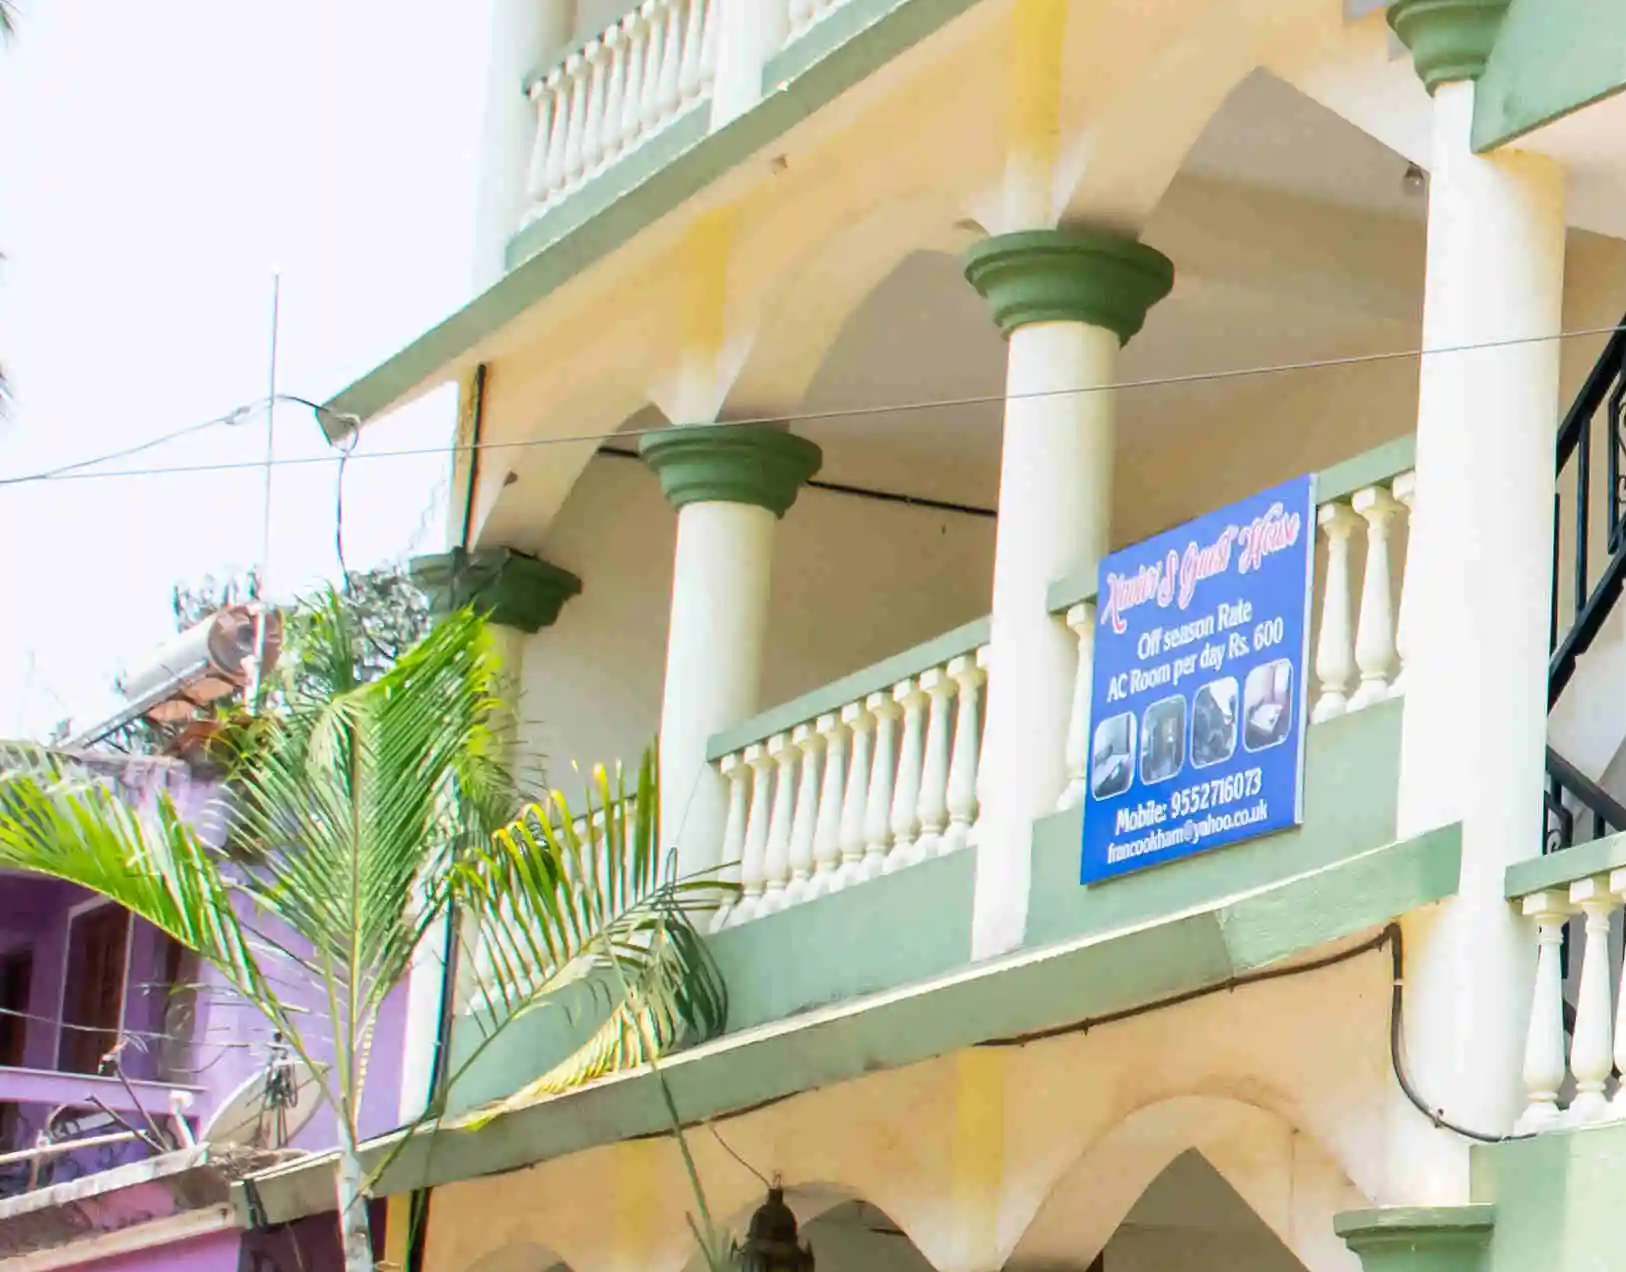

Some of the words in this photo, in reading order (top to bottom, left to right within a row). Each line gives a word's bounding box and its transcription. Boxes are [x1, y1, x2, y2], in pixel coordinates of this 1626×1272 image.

[1107, 673, 1128, 703] AC
[1130, 663, 1171, 694] Room
[1173, 653, 1198, 686] per
[1200, 642, 1226, 671] day
[1228, 632, 1250, 659] Rs.
[1253, 616, 1284, 651] 600
[1137, 628, 1162, 660] Off
[1163, 615, 1214, 651] season
[1218, 599, 1252, 631] Rate
[1115, 799, 1168, 836] Mobile:
[1171, 767, 1263, 819] 9552716073
